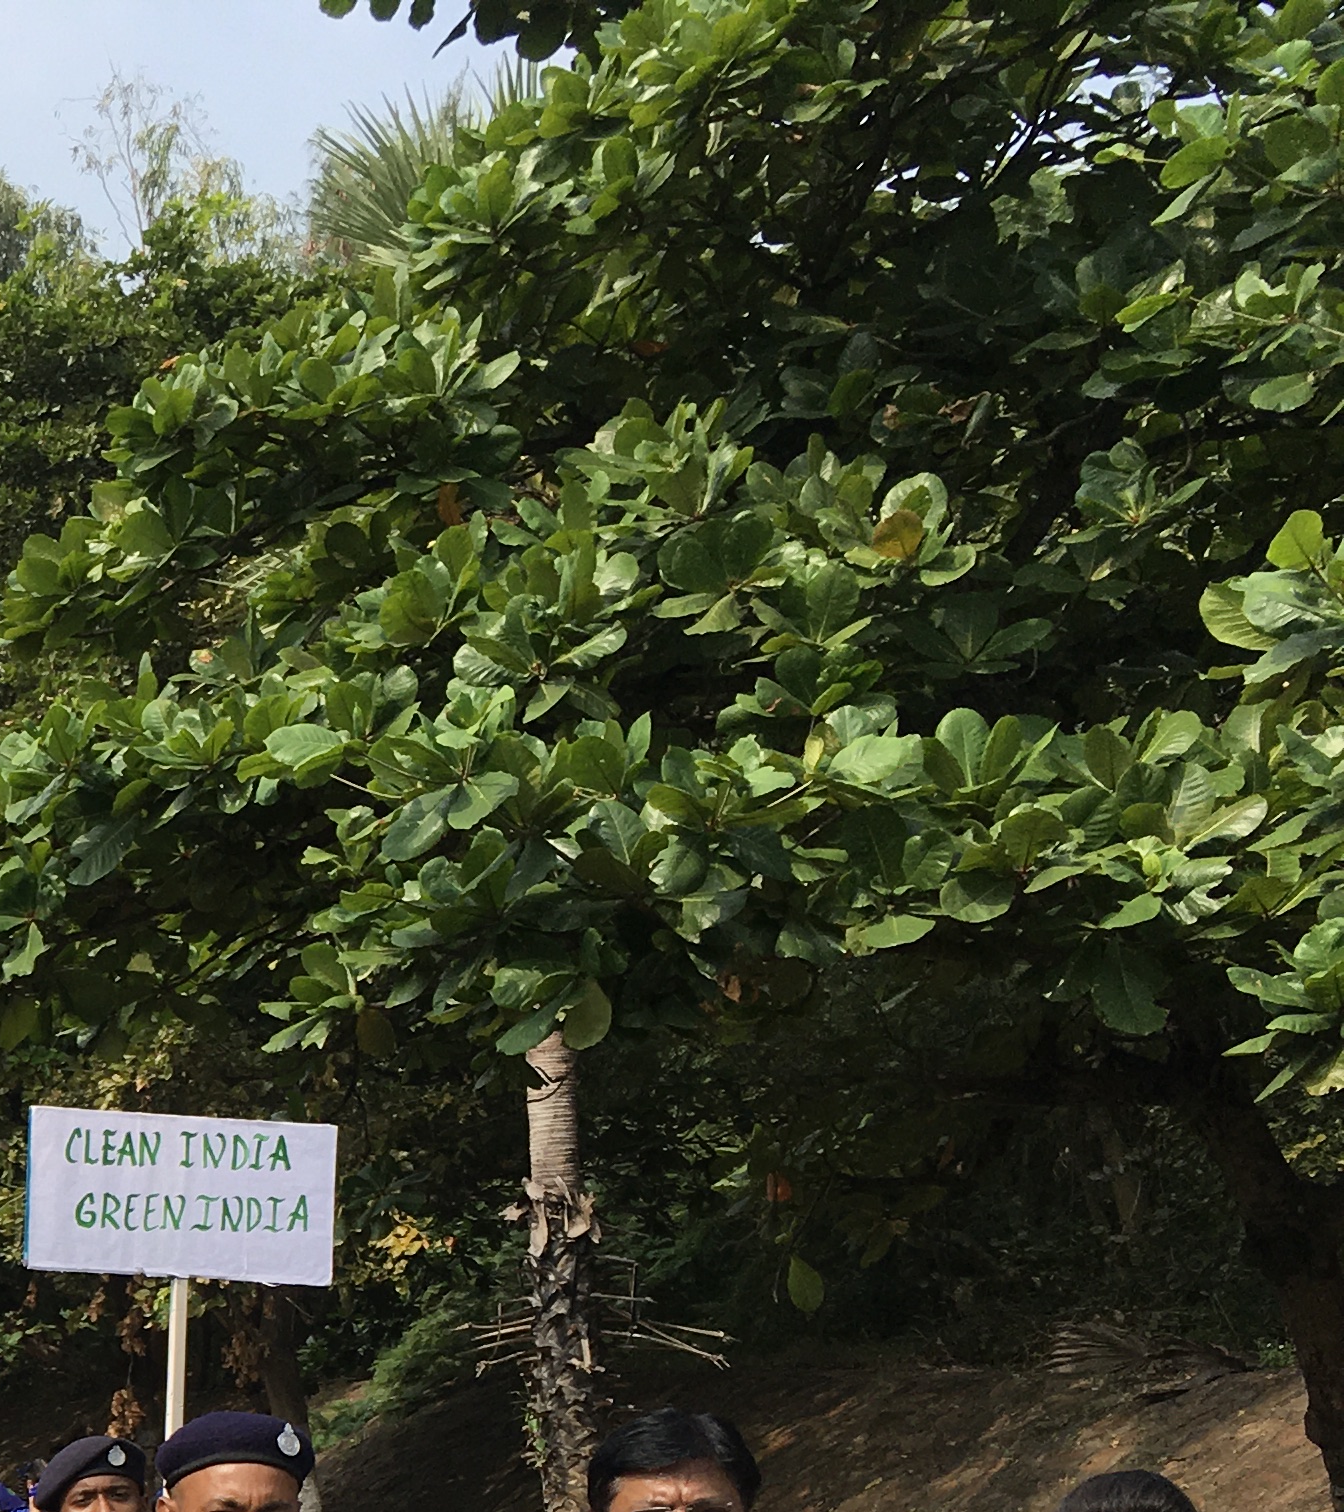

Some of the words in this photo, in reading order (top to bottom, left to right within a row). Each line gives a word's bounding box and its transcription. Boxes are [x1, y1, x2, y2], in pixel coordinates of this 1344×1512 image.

[64, 1127, 162, 1167] CLEAN
[178, 1130, 292, 1172] INDIA
[74, 1192, 187, 1232] GREEN
[189, 1193, 309, 1233] INDIA
